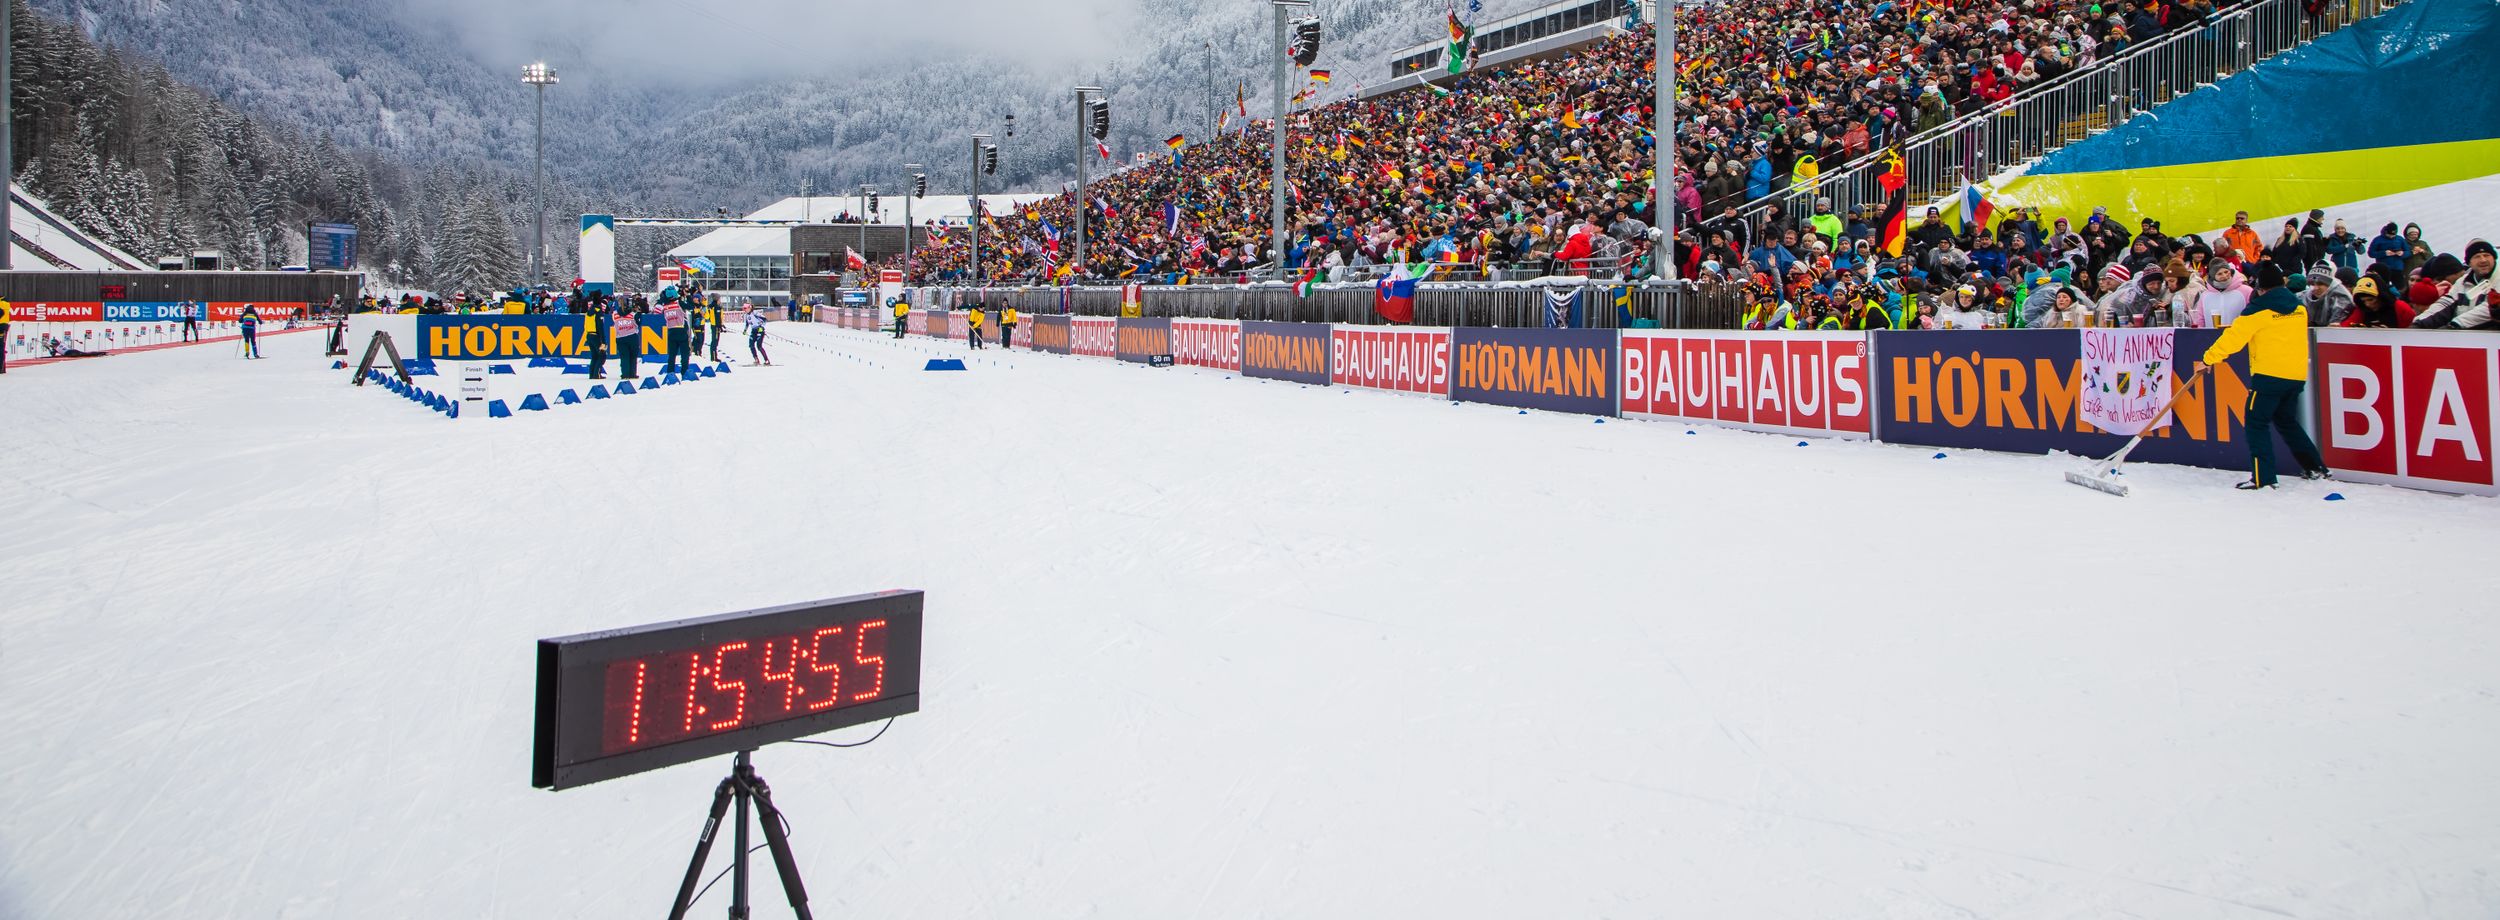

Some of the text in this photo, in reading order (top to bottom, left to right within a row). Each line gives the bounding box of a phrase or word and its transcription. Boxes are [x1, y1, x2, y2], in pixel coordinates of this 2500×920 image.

[9, 303, 92, 321] VIESSMANN
[107, 306, 140, 318] DKB
[1071, 325, 1115, 352] BAUHAUS
[1119, 325, 1168, 356] HÖRMANN
[1173, 328, 1239, 364] BAUHAUS
[1245, 331, 1325, 374] HÖRMANN
[2086, 331, 2117, 364] SVW
[1153, 355, 1162, 363] 50
[1334, 338, 1447, 385] BAUHAUS
[1459, 339, 1606, 399] HÖRMANN
[1625, 347, 1864, 417] BAUHAUS
[2328, 362, 2484, 462] BA
[629, 620, 886, 742] 11:54:55
